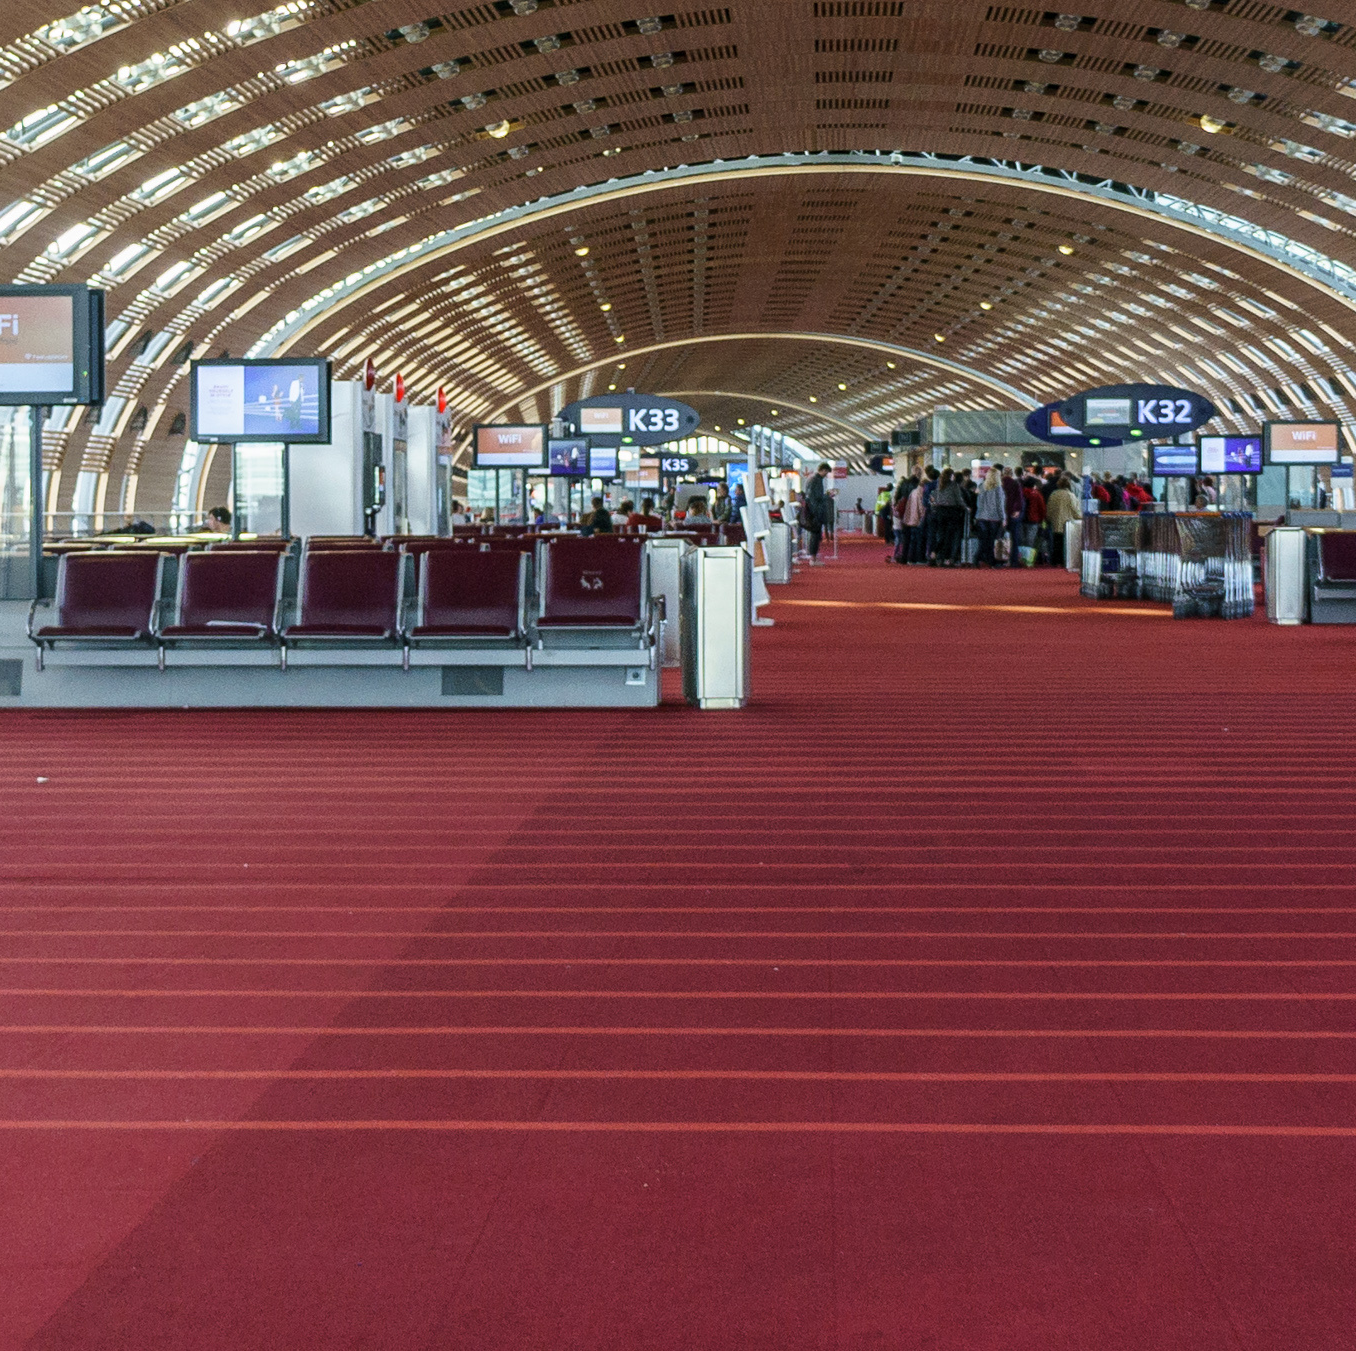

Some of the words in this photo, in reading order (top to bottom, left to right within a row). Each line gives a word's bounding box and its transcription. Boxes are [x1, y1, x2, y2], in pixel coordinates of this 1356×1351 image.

[1138, 399, 1192, 424] K32
[629, 408, 680, 432] K33
[498, 433, 522, 444] WiFi
[1291, 430, 1317, 441] WiFi
[662, 458, 689, 472] K35
